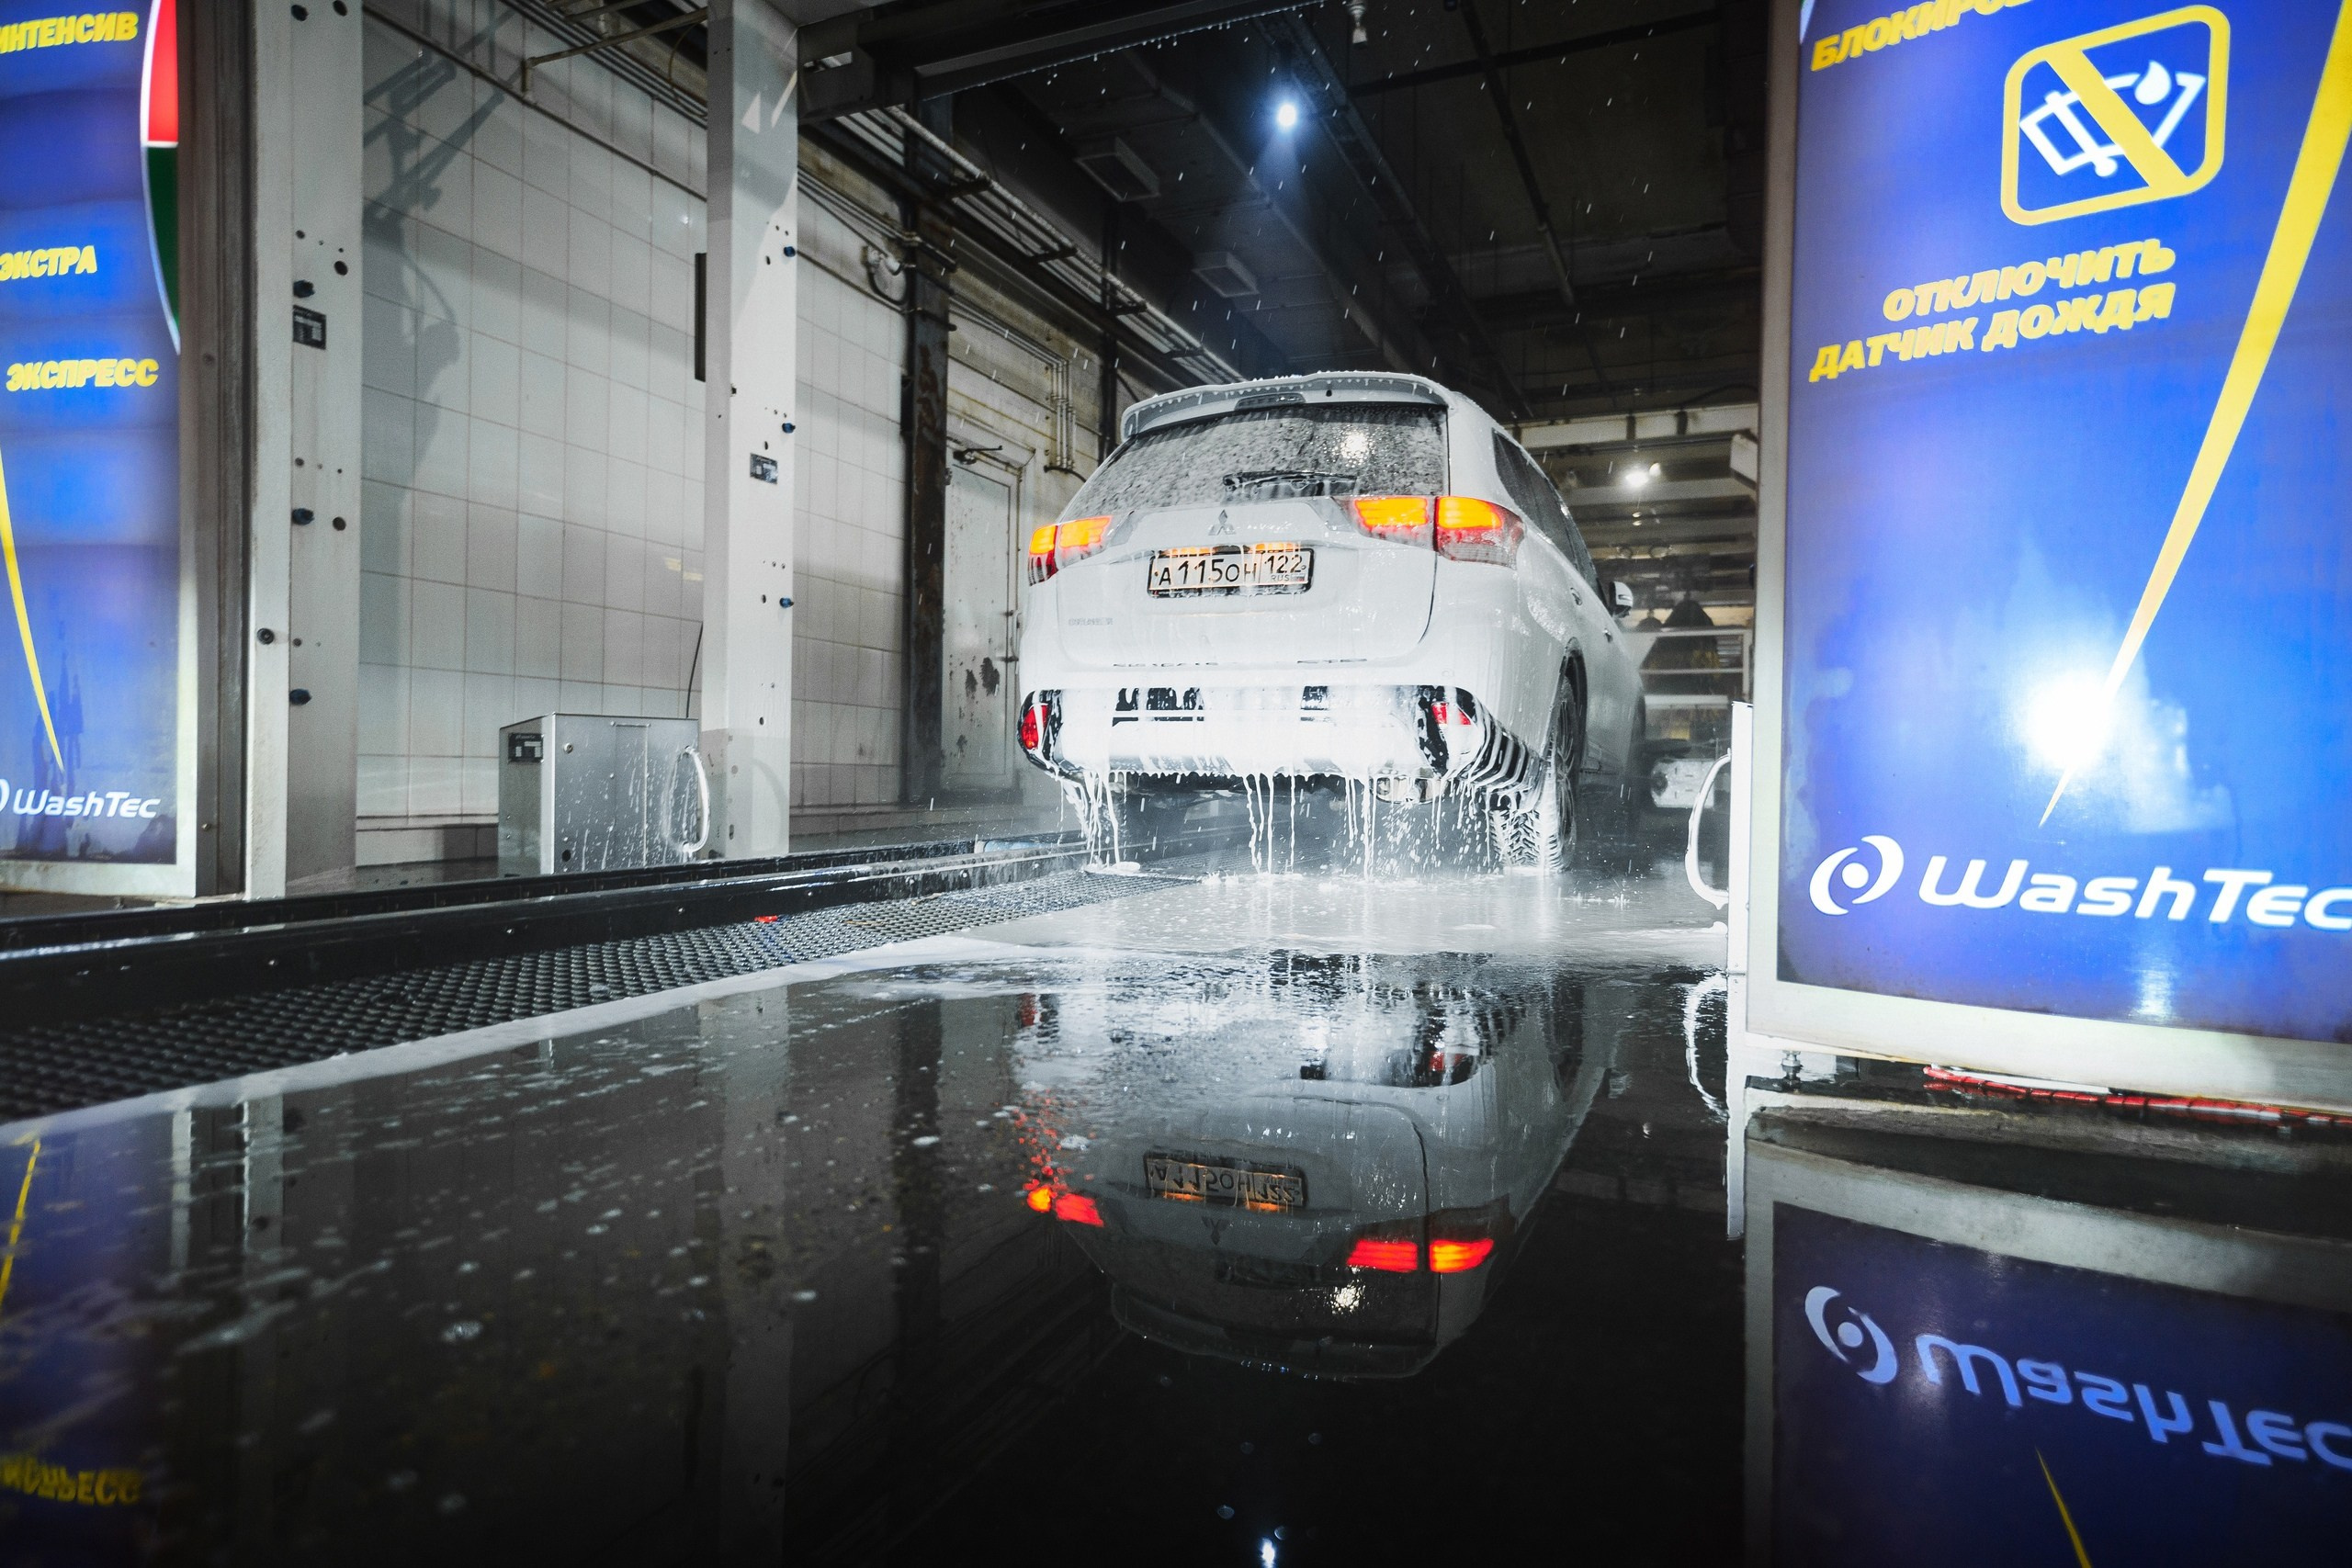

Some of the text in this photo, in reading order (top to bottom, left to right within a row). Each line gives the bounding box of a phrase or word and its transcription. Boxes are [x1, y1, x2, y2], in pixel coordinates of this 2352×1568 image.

[1810, 0, 2033, 72] БЛОКИР
[0, 245, 97, 281] ЭКСТРА
[1883, 238, 2177, 322] ОТКЛЮЧИТЬ
[1808, 282, 2177, 382] ДАТЧИК ДОЖДЯ
[6, 358, 159, 391] ЭКСПРЕСС
[1264, 553, 1304, 575] 122
[13, 789, 161, 818] WashTec
[1918, 855, 2352, 931] WashTec
